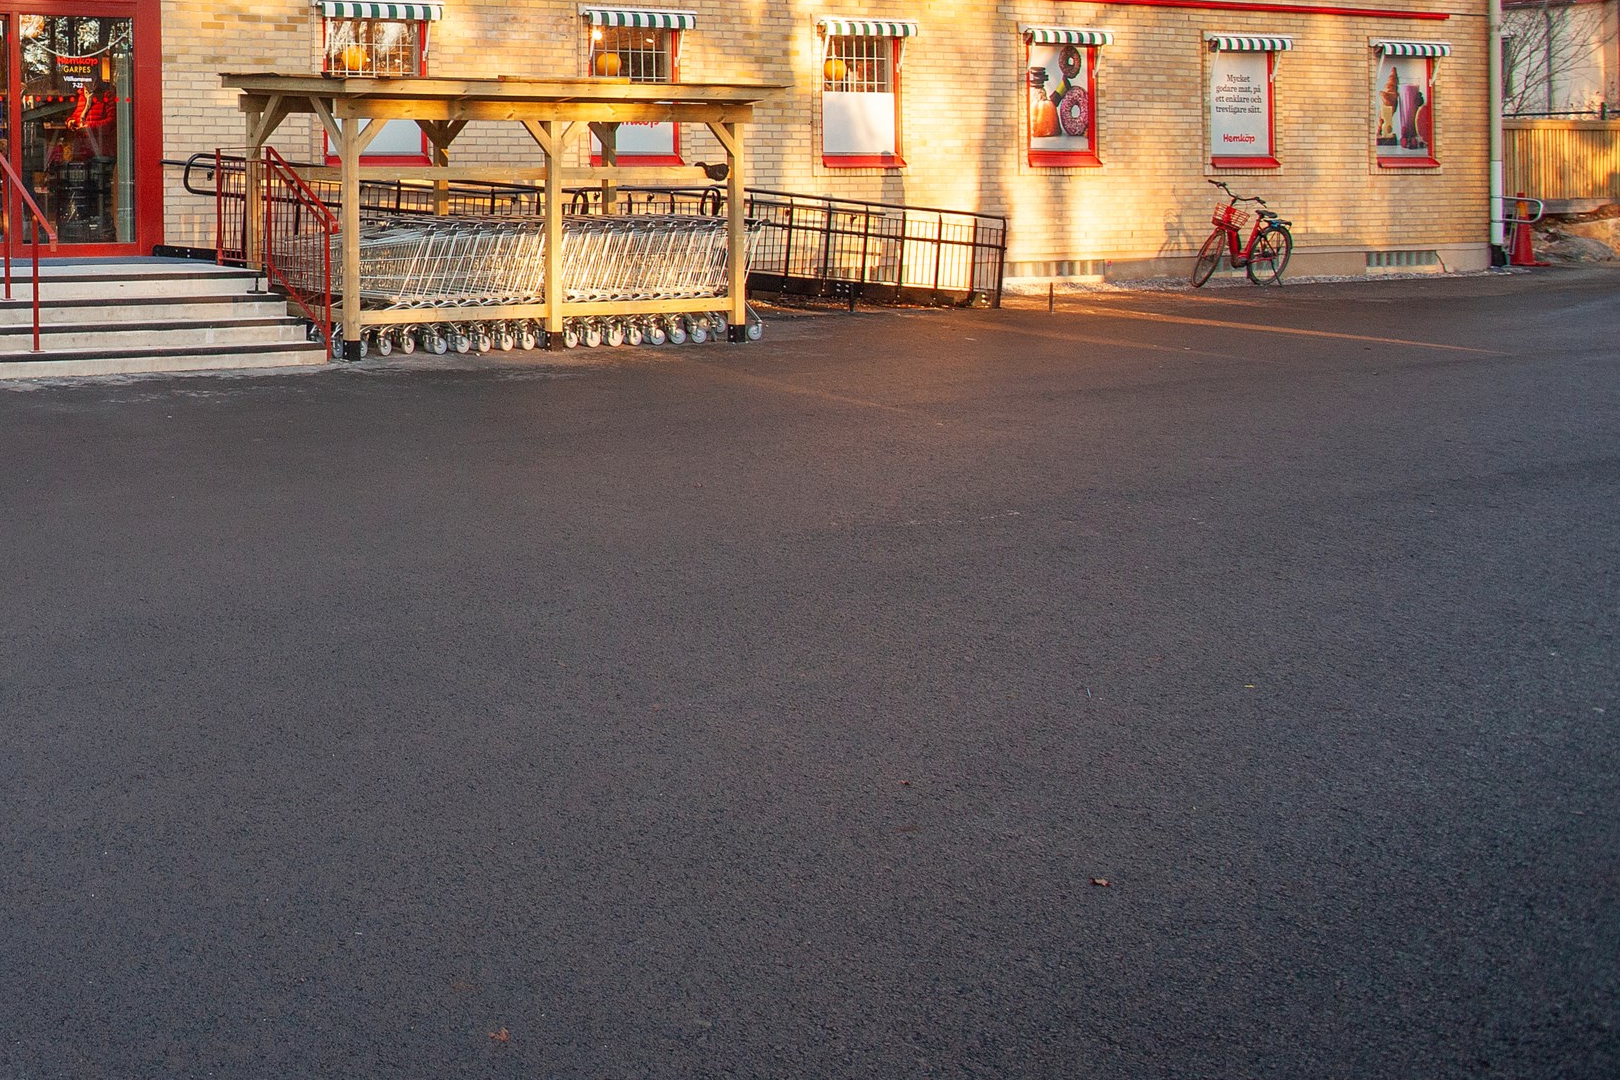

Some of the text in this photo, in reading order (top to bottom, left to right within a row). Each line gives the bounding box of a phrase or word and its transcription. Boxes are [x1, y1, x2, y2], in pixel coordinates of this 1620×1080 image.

[63, 65, 91, 73] GARPES
[1226, 73, 1250, 83] Mycket
[1216, 84, 1237, 94] godare
[1253, 84, 1261, 94] på
[1225, 95, 1249, 103] enklare
[1251, 95, 1262, 103] och
[1215, 105, 1262, 114] trevligare sätt.
[1223, 133, 1256, 144] Hemköp
